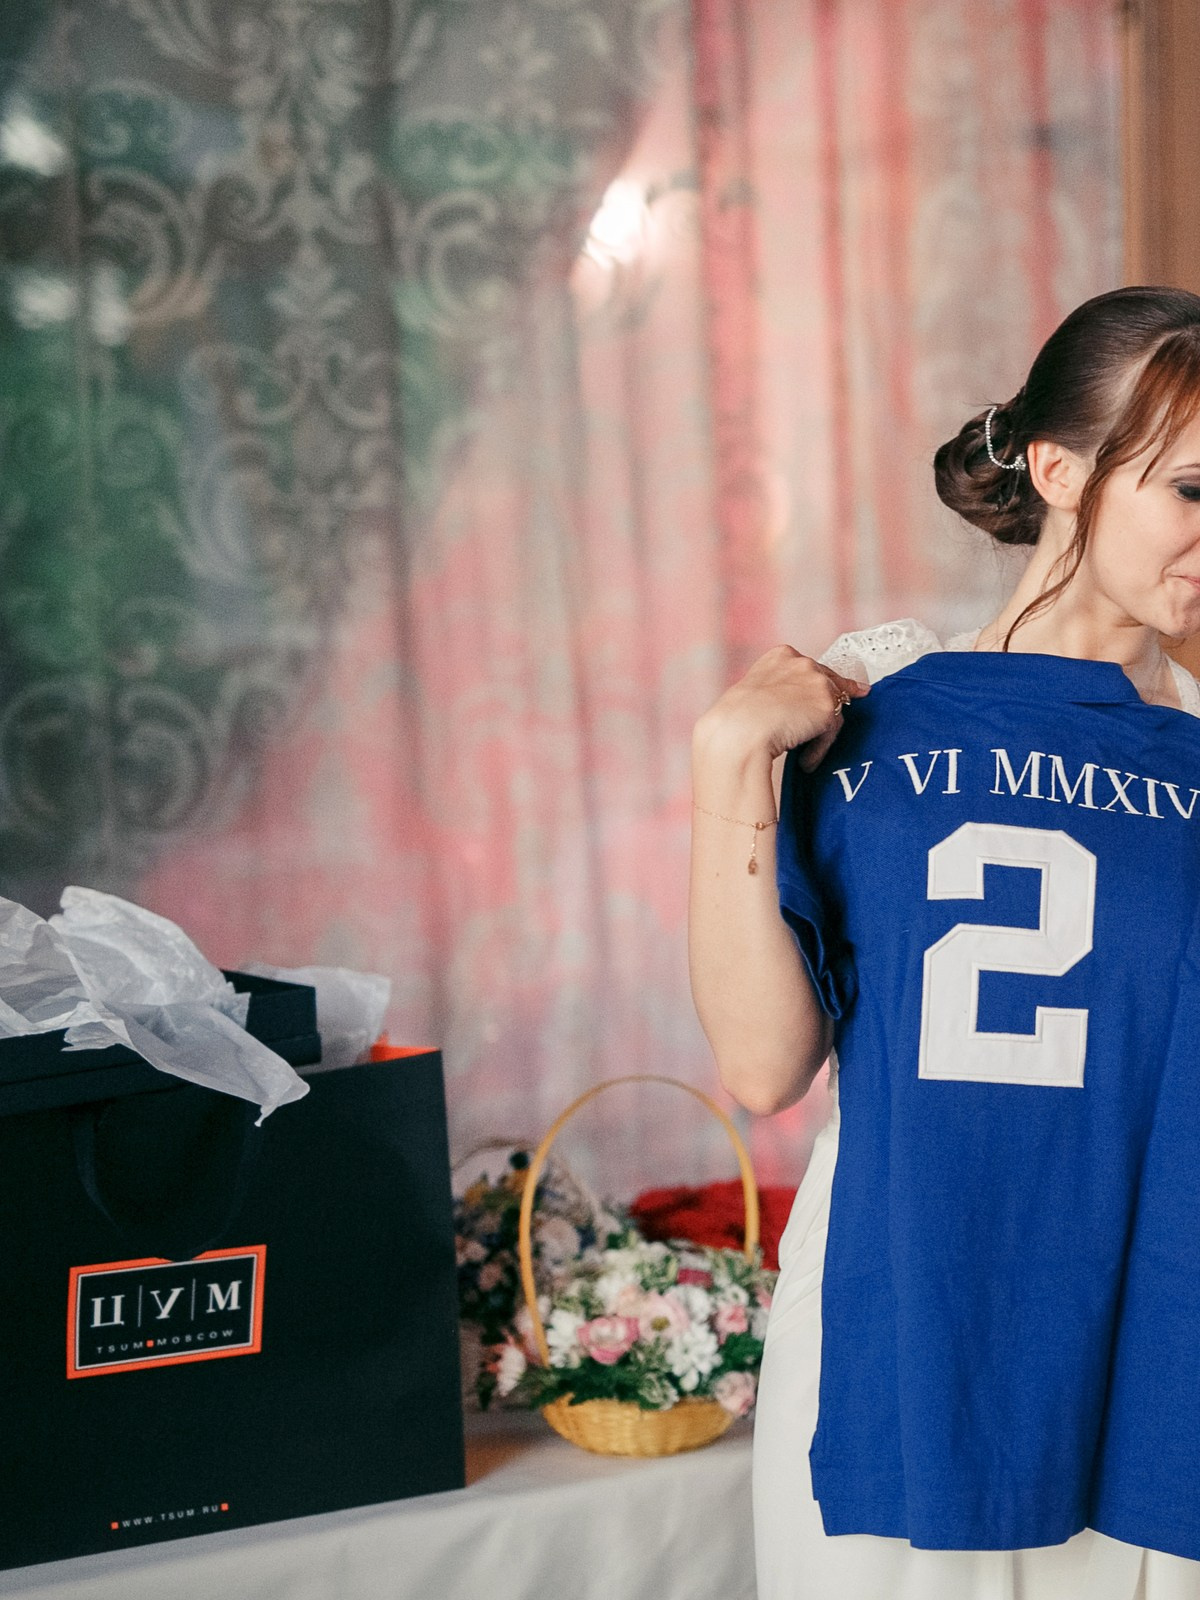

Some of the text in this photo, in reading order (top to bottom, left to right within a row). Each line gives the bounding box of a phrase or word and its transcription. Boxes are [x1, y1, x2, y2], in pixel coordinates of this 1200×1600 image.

[832, 761, 873, 802] V
[897, 748, 963, 795] VI
[917, 821, 1097, 1089] 2
[157, 1329, 233, 1346] MOSCOW
